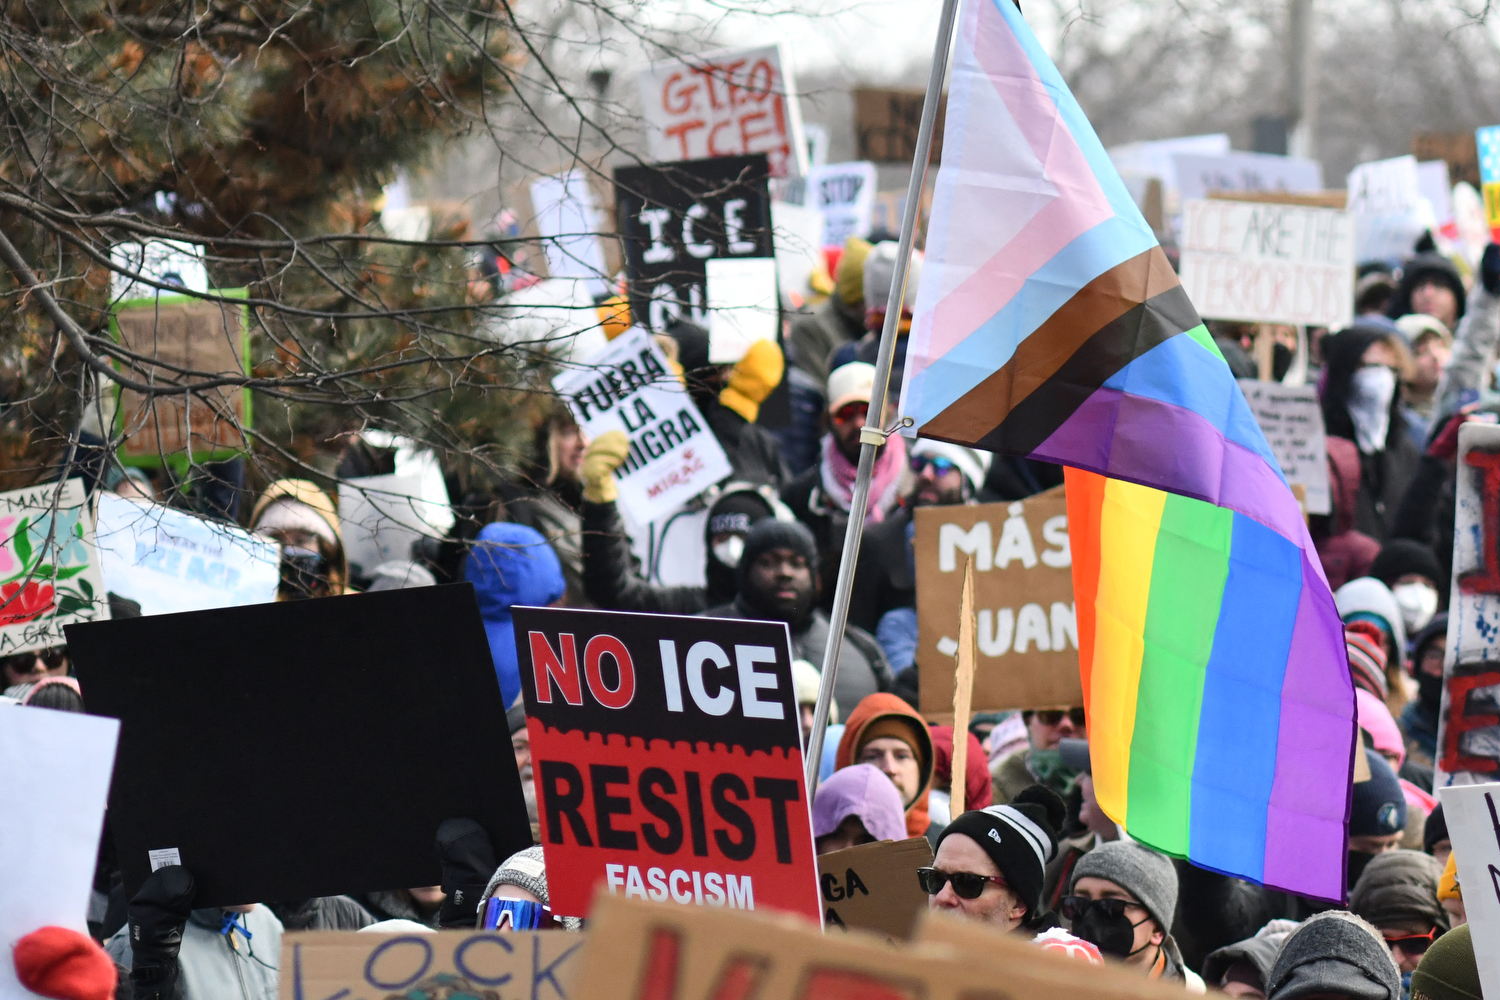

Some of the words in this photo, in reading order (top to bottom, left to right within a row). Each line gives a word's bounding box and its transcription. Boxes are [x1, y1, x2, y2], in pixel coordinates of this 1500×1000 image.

[638, 198, 757, 264] ICE
[1186, 202, 1237, 251] ICE
[1241, 208, 1295, 258] ARE
[1297, 207, 1349, 263] THE
[573, 348, 666, 422] FUERA
[617, 397, 657, 434] LA
[938, 501, 1072, 573] MÁS
[23, 616, 80, 645] GRE
[528, 630, 636, 710] NO
[658, 639, 785, 720] ICE
[539, 760, 800, 864] RESIST
[605, 863, 755, 910] FASCISM
